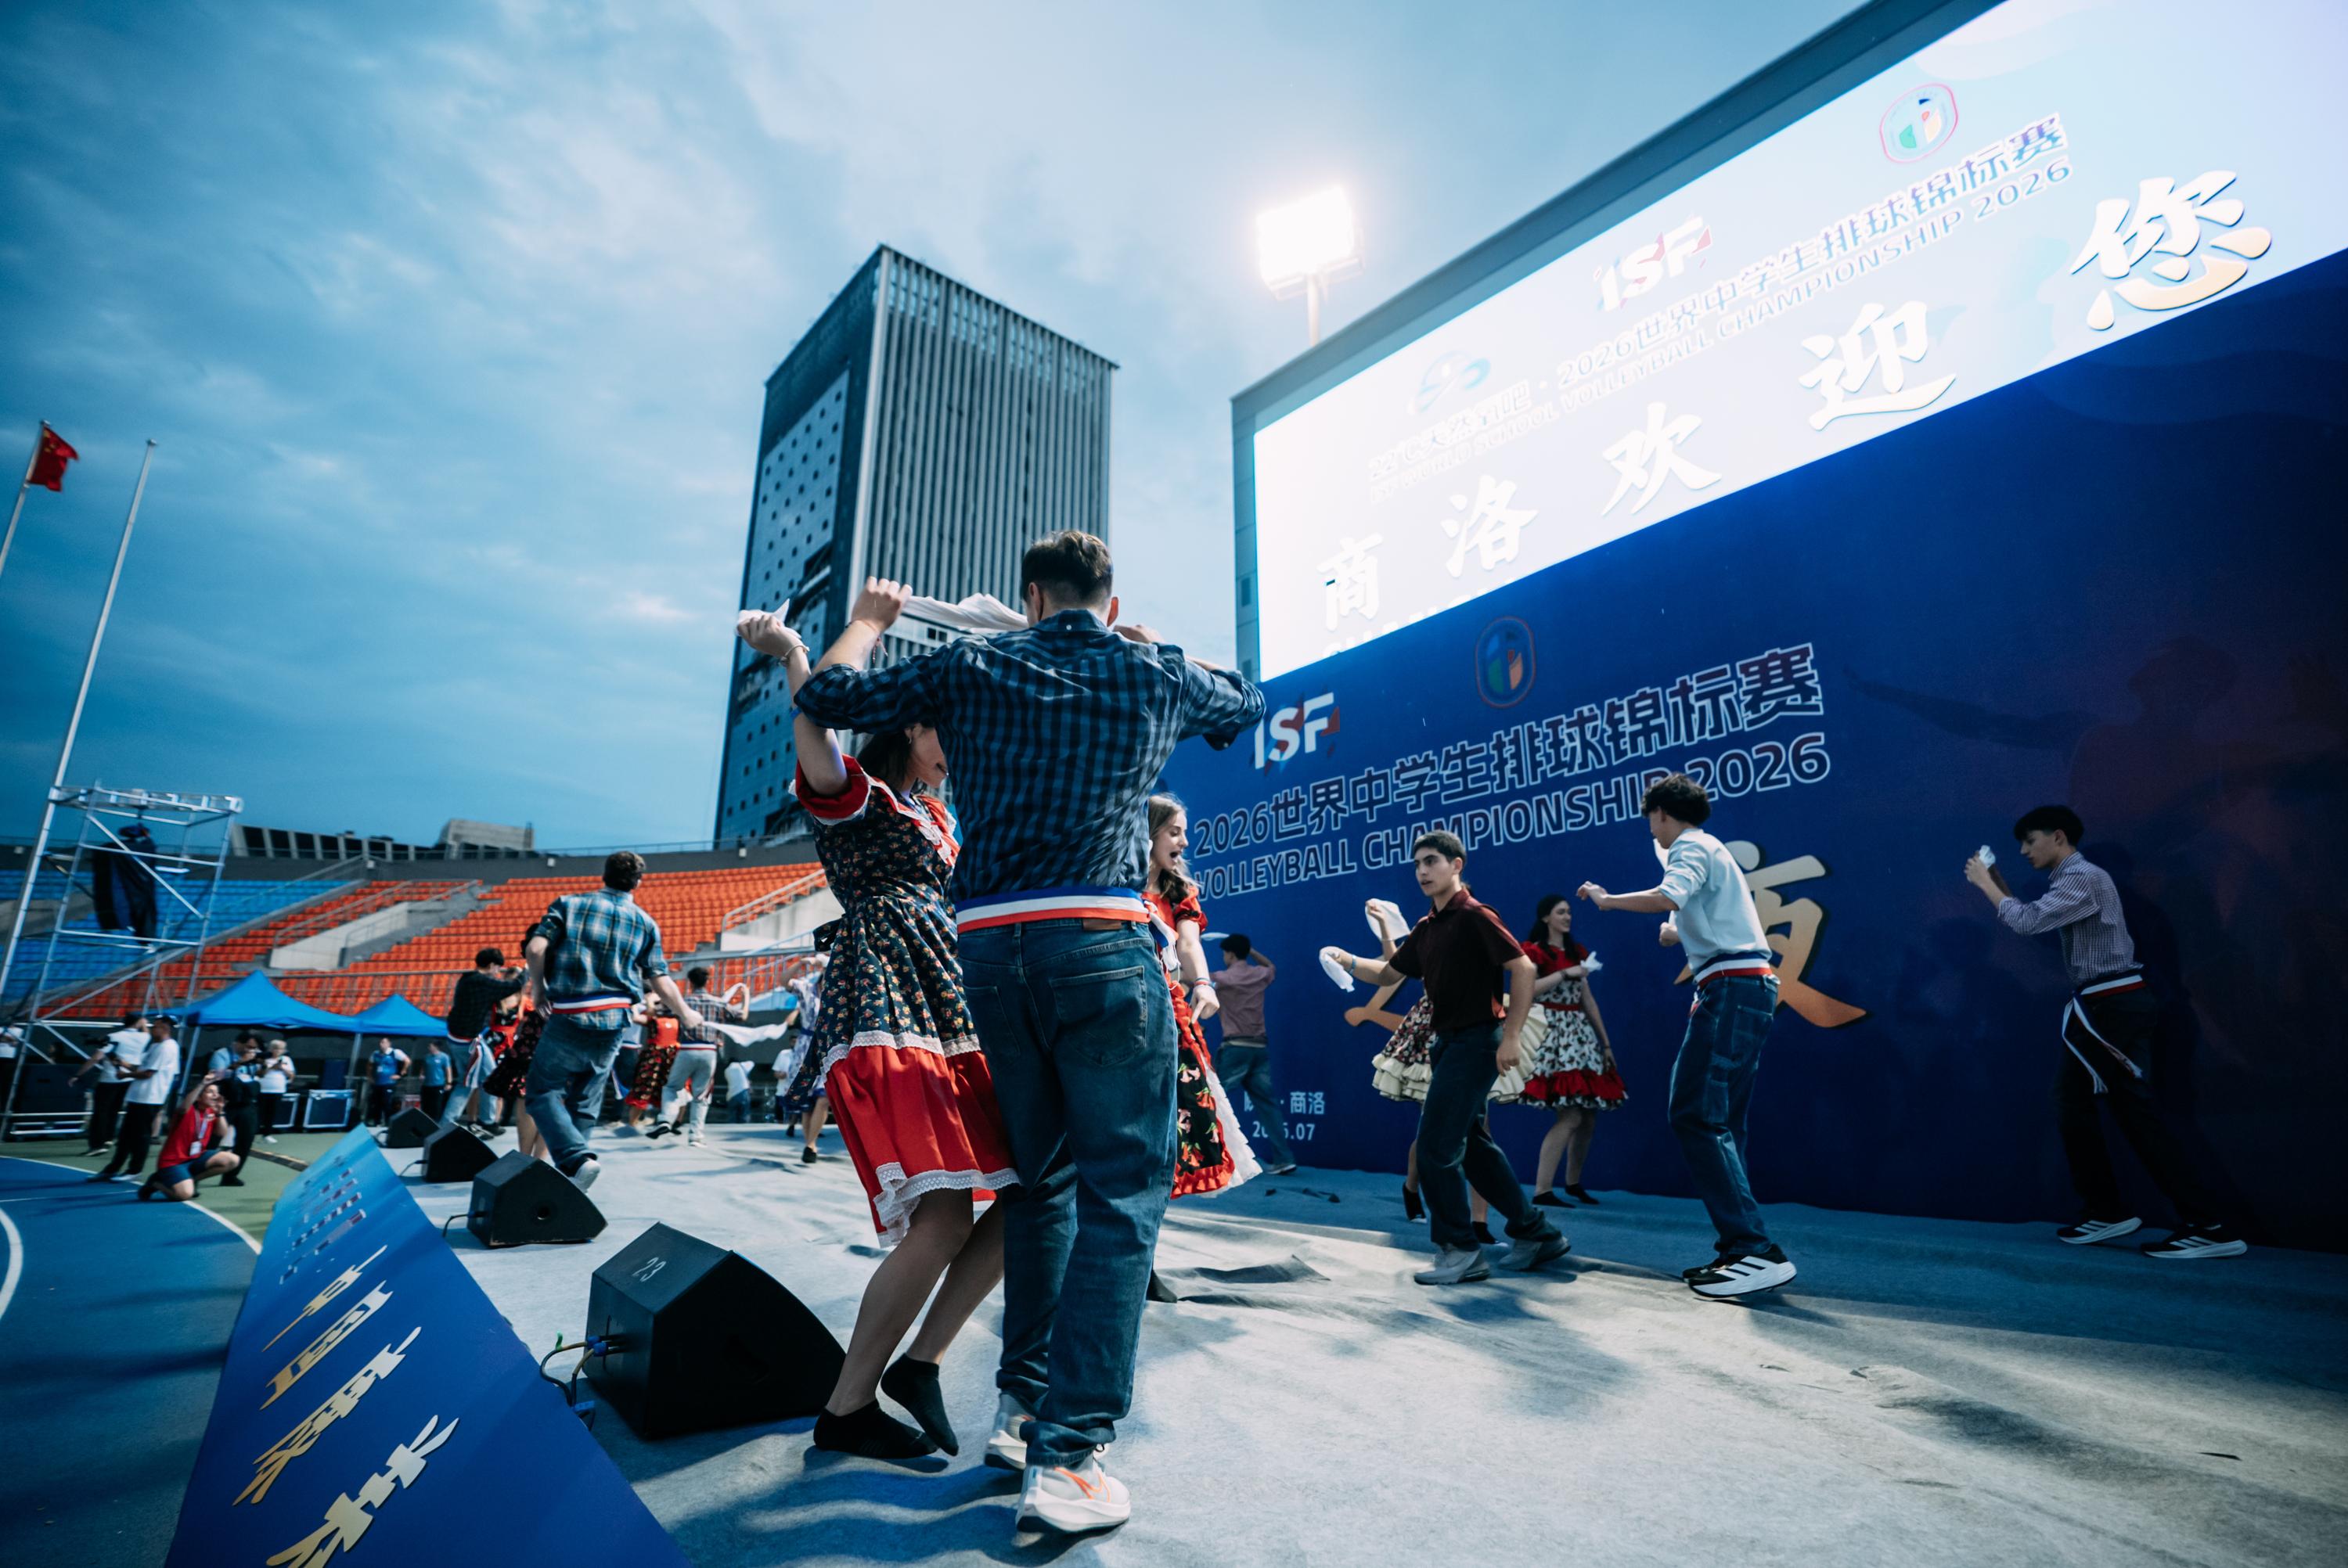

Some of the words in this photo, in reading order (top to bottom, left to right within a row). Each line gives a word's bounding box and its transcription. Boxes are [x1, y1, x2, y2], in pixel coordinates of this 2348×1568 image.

[1474, 400, 1560, 455] SCHOOL
[1562, 323, 1714, 415] VOLLEYBALL
[1720, 208, 1963, 340] CHAMPIONSHIP
[1975, 159, 2073, 221] 2026
[1597, 217, 1712, 312] ISF
[1316, 171, 2272, 632] 商洛欢迎您
[1194, 642, 1824, 858] 2026世界中学生排球锦标赛
[1254, 692, 1340, 770] ISF
[1195, 839, 1357, 903] VOLLEYBALL
[1684, 732, 1831, 804] 2026
[632, 1257, 667, 1282] 23
